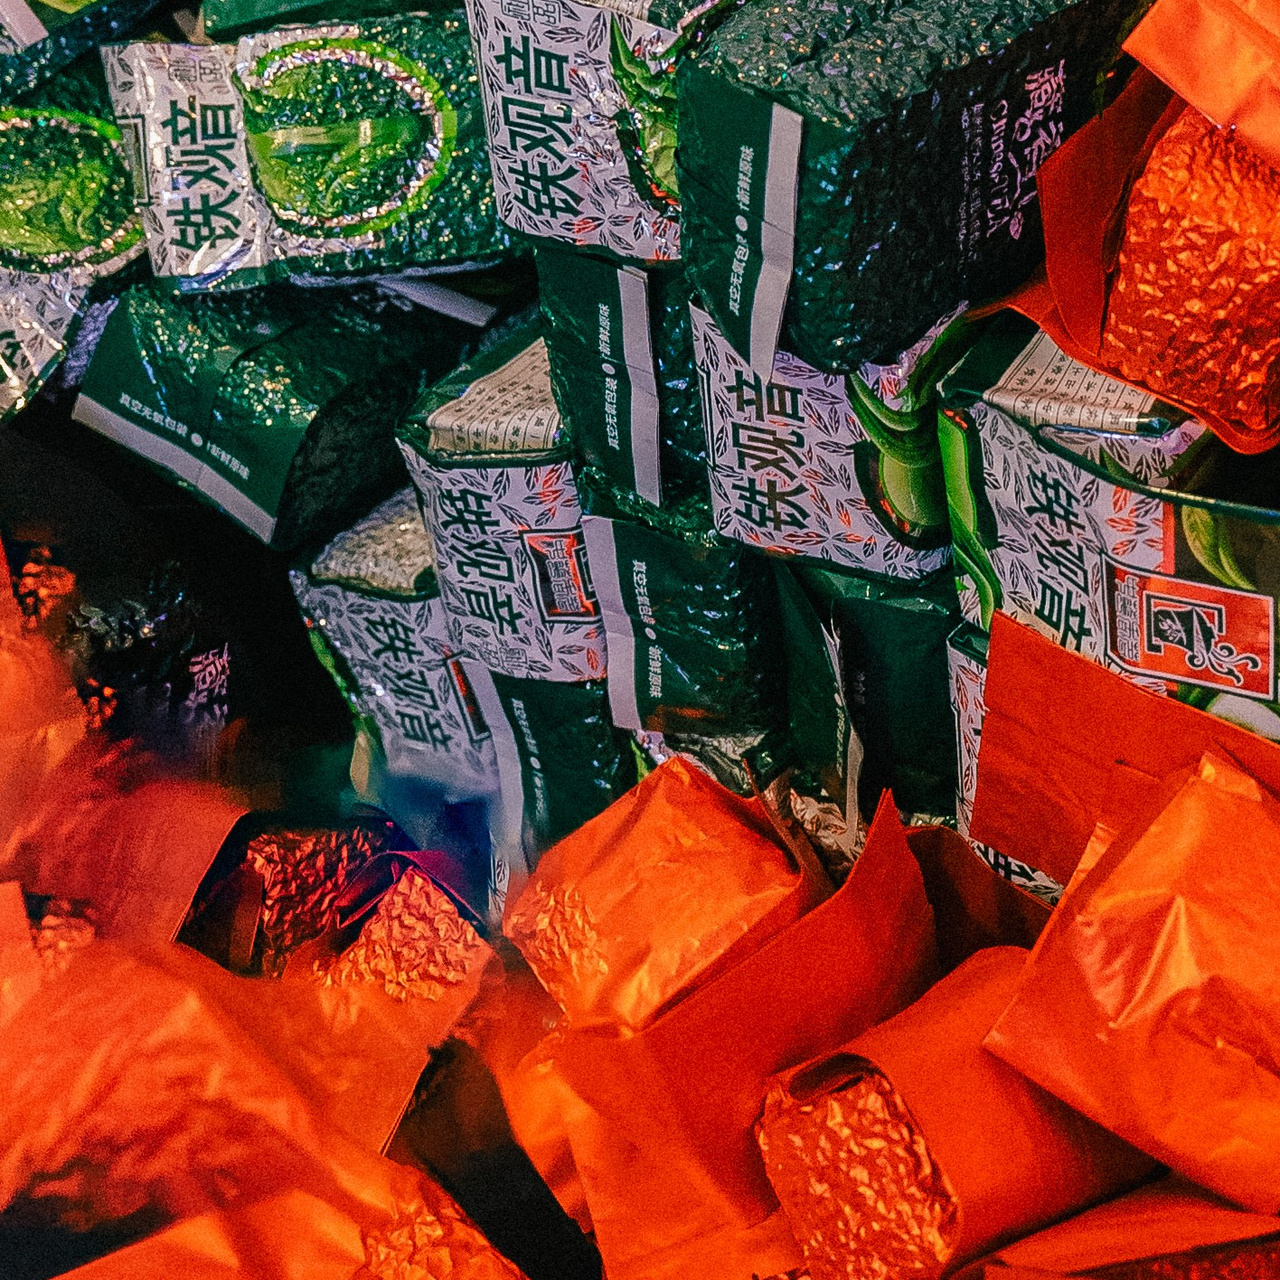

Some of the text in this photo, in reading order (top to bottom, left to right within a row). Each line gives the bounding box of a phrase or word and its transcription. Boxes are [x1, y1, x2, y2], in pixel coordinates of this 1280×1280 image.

[162, 96, 237, 250] 铁观音
[495, 35, 580, 221] 铁观音
[738, 145, 756, 211] 新鲜原味
[598, 304, 611, 355] 新鲜原味
[731, 374, 807, 534] 铁观音
[438, 489, 523, 635] 铁观音
[1025, 466, 1091, 652] 铁观音
[367, 615, 452, 754] 铁观音
[647, 644, 662, 699] 新鲜原味
